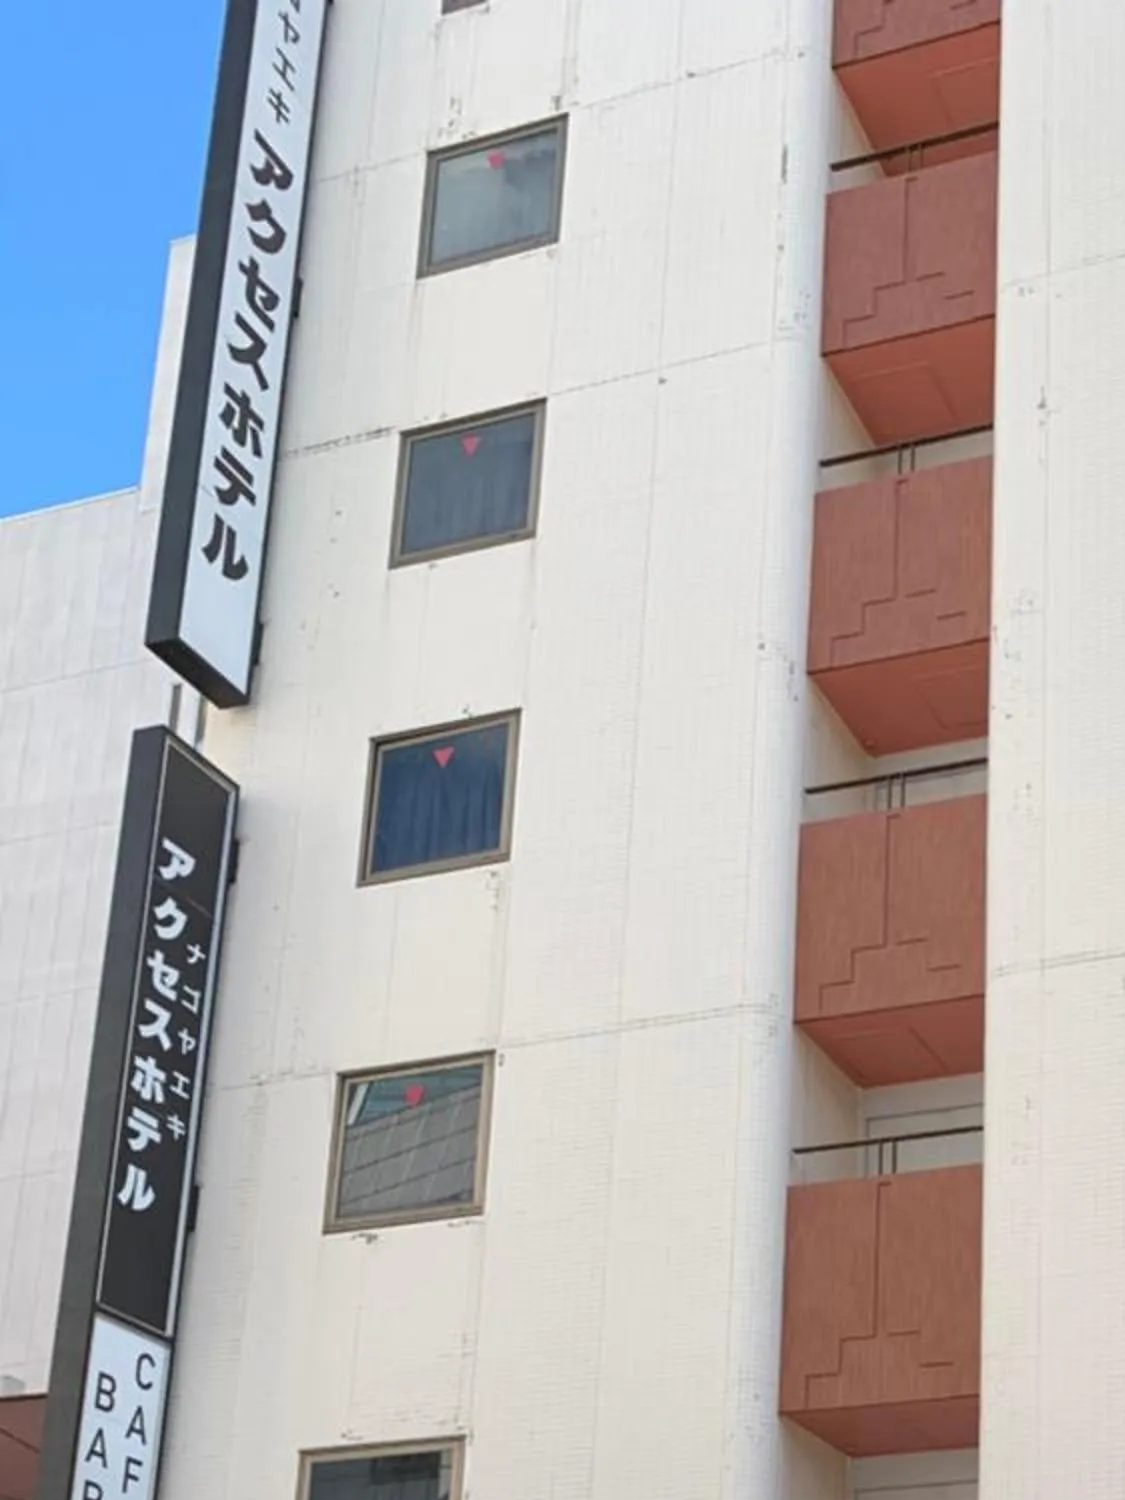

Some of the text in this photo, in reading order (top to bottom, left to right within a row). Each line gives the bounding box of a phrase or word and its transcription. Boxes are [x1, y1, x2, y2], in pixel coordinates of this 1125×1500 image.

[202, 128, 295, 581] アクセスホテル
[118, 837, 196, 1211] アクセスホテル
